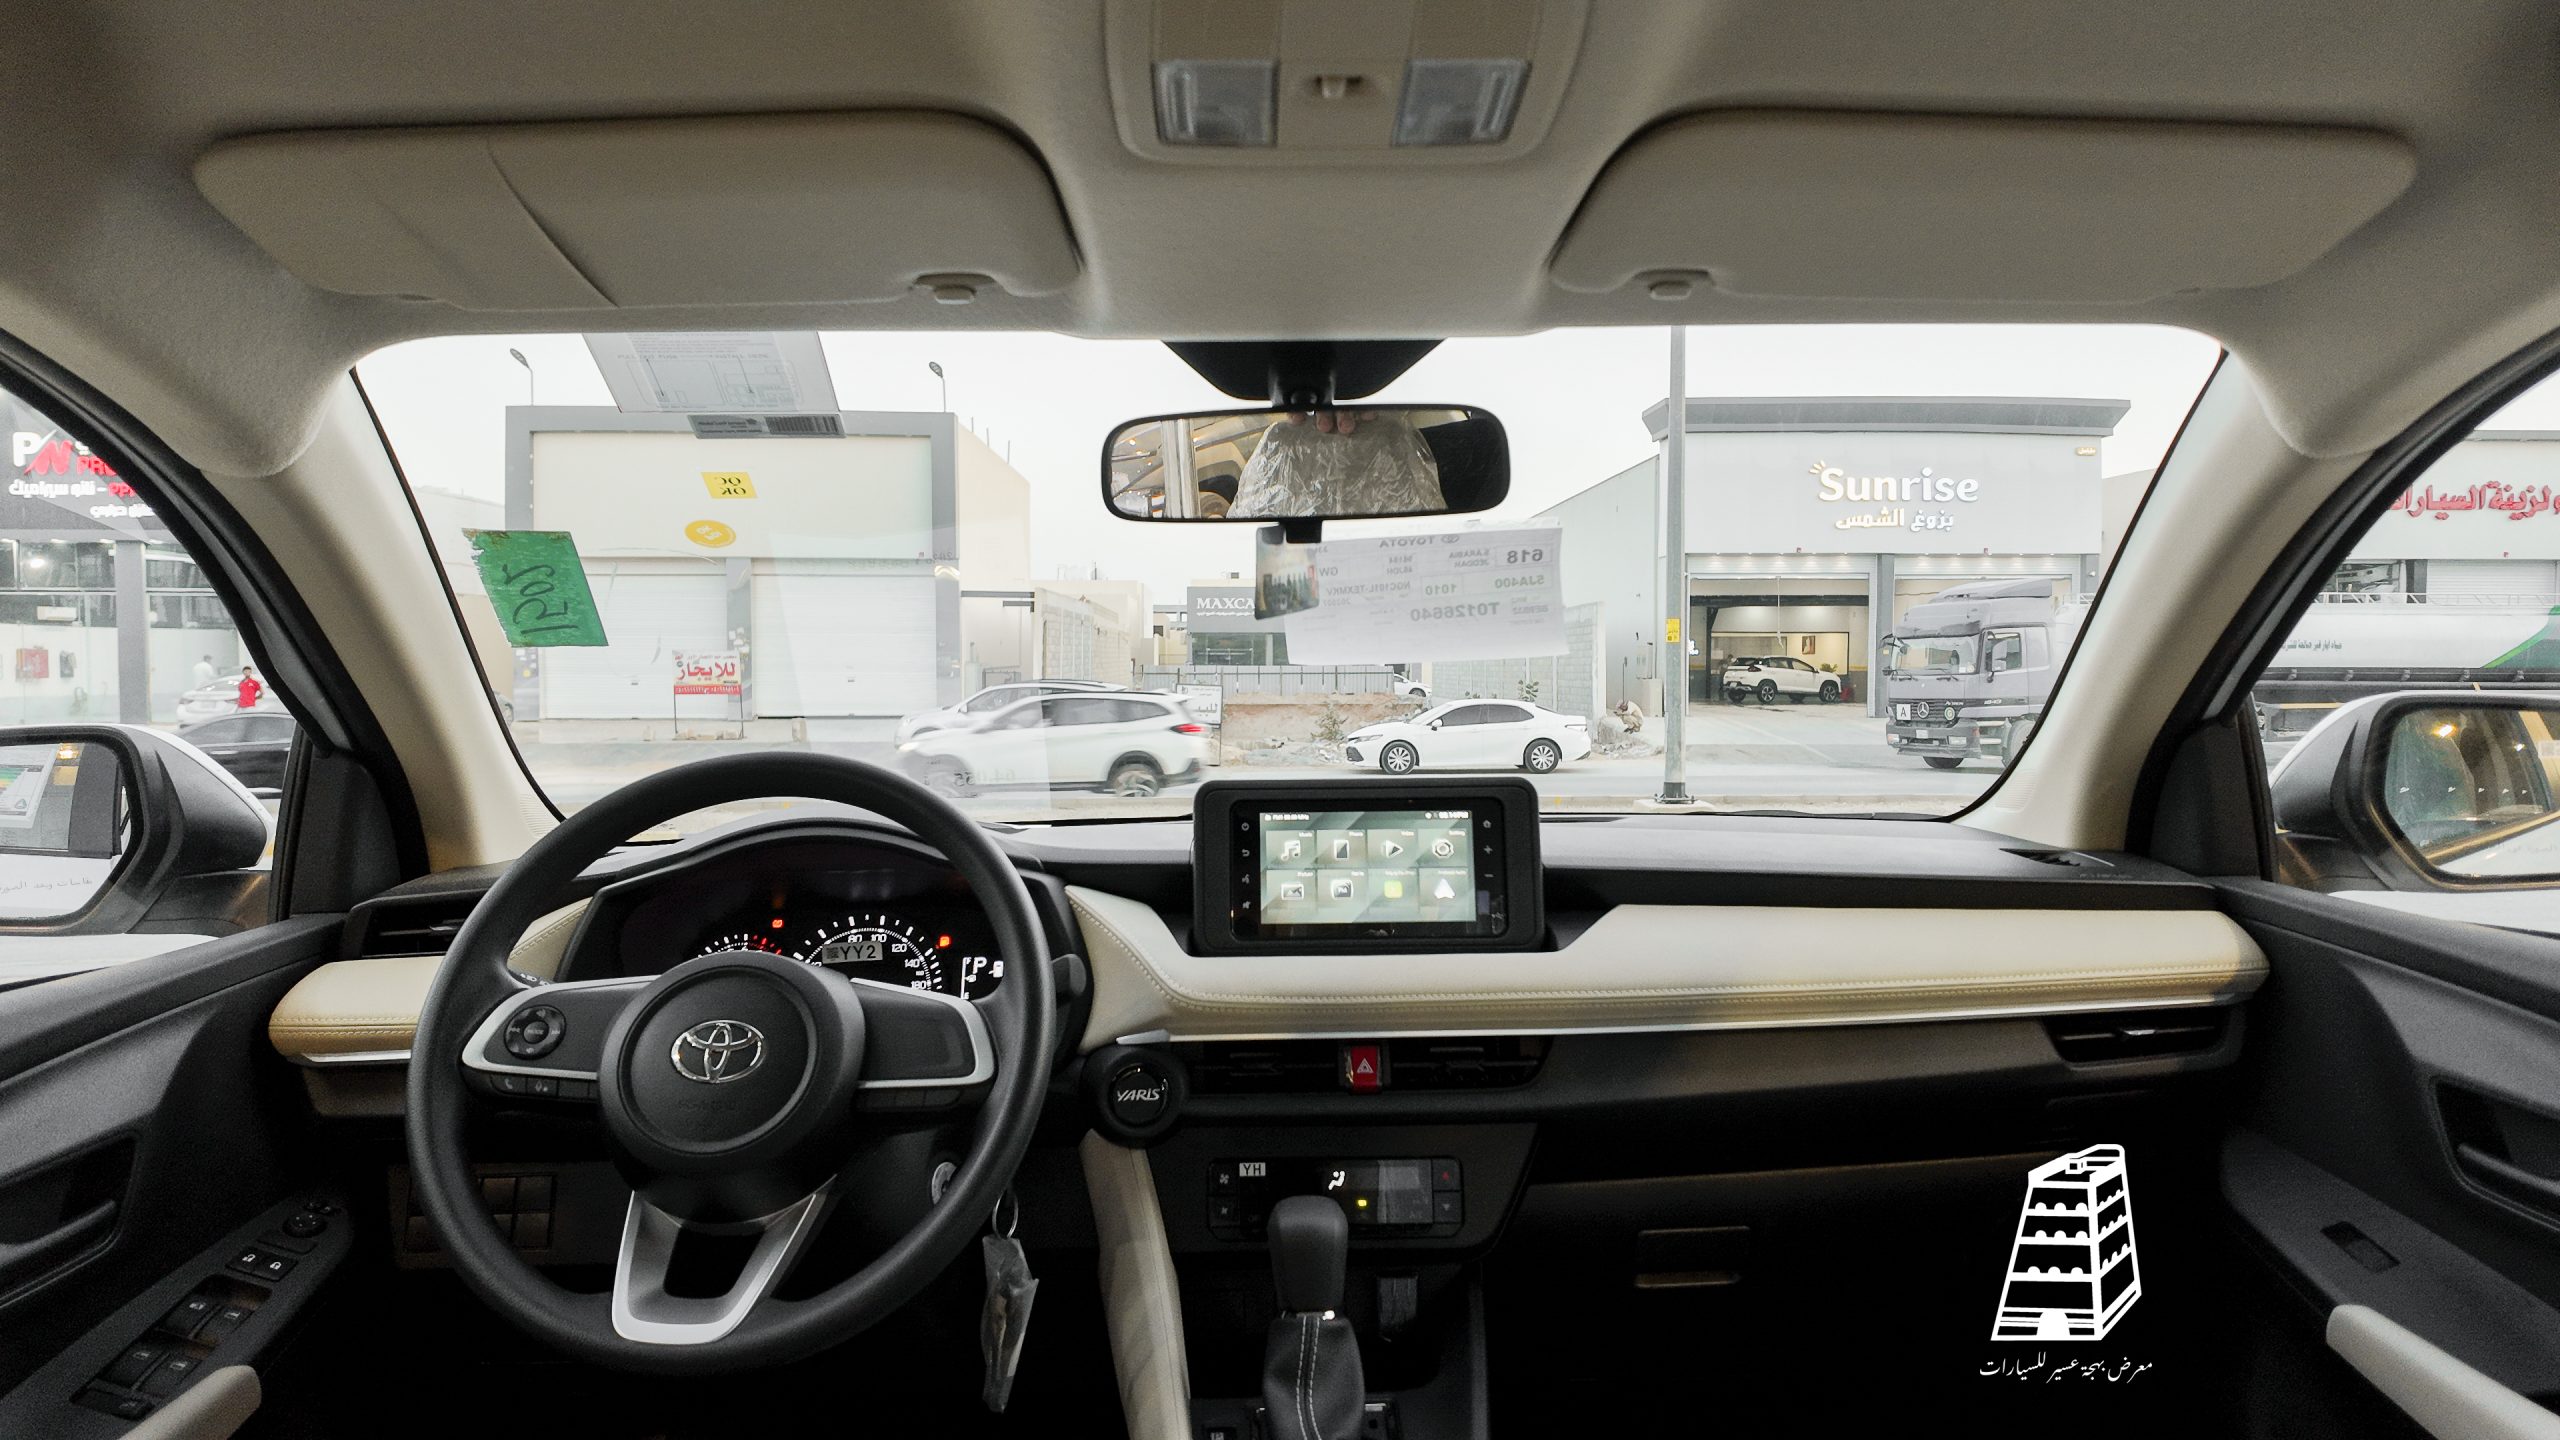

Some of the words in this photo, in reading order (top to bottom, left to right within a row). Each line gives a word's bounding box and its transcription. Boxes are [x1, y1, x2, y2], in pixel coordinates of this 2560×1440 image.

[76, 456, 117, 477] PR
[1818, 467, 1979, 502] Sunrise
[1835, 505, 1905, 530] الشمس
[1909, 509, 1955, 532] بزوغ
[871, 934, 887, 943] 100
[891, 943, 908, 953] 120
[904, 959, 921, 968] 140
[973, 957, 987, 975] P
[1117, 1087, 1161, 1102] YARIS
[1243, 1163, 1262, 1175] YH
